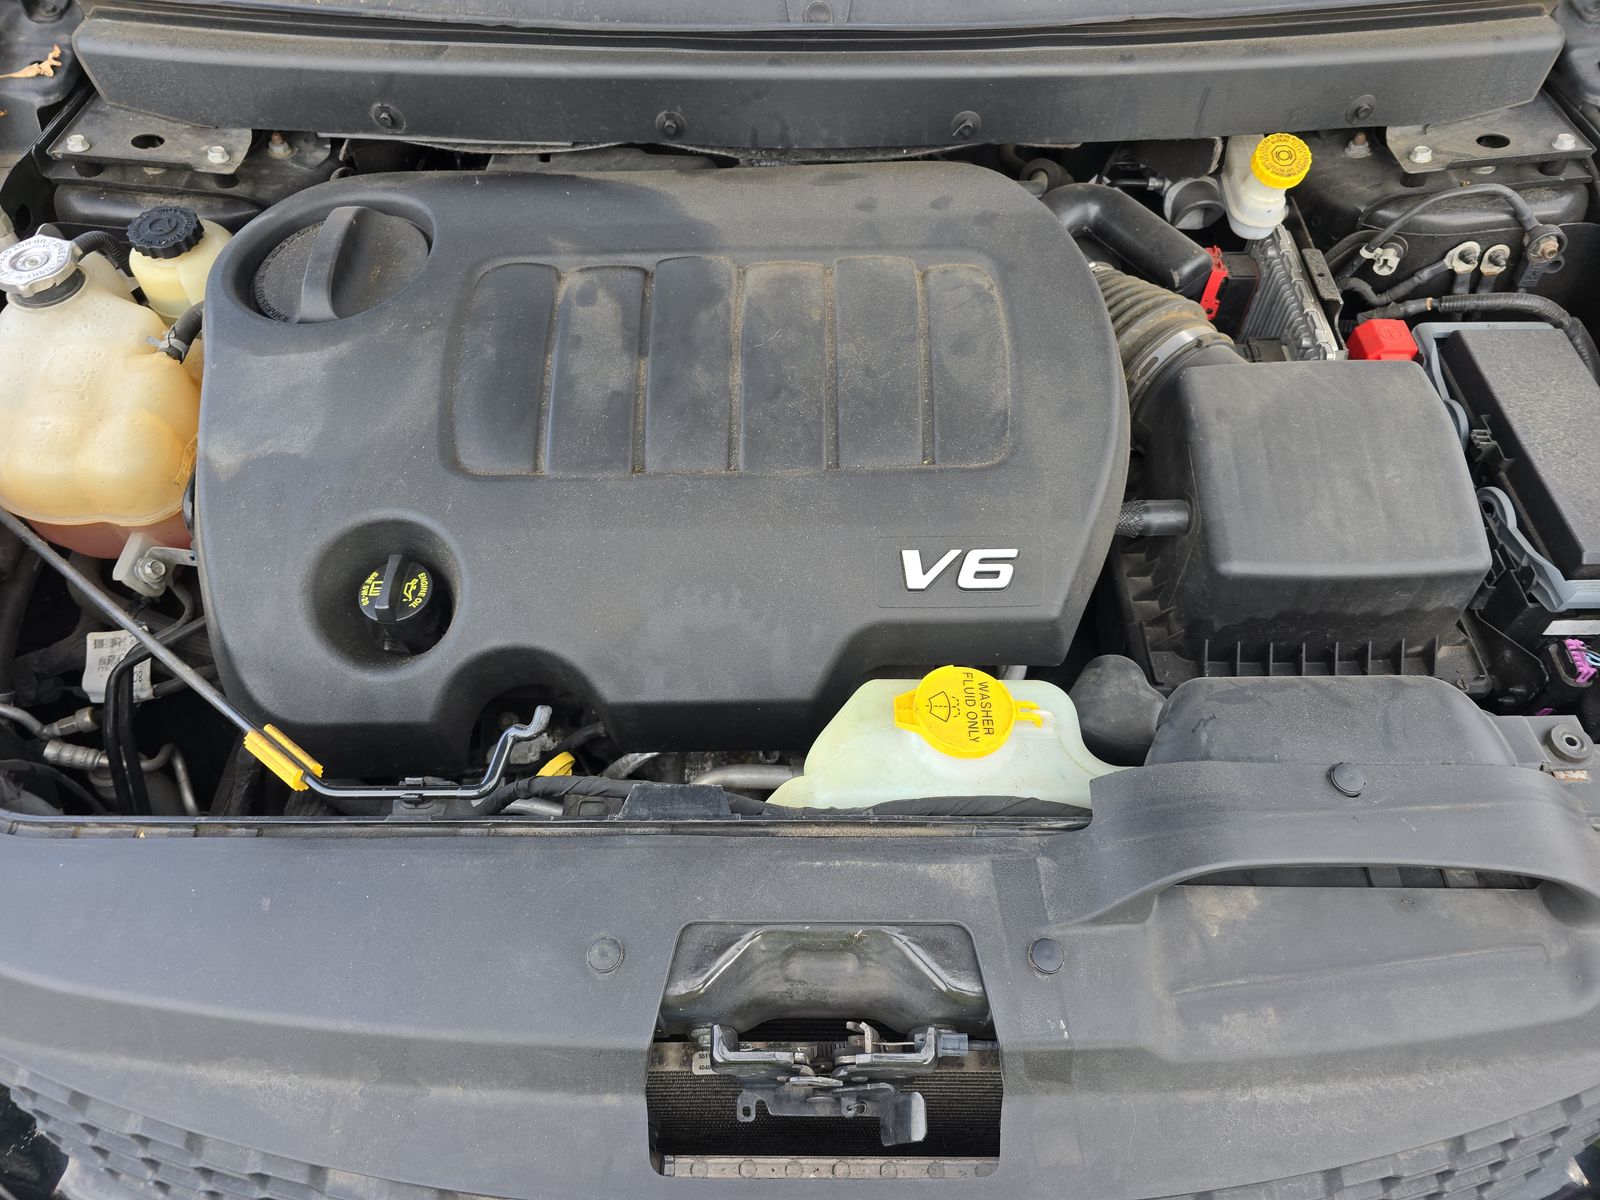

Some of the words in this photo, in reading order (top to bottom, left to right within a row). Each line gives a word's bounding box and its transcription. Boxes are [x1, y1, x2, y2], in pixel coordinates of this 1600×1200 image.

[365, 571, 379, 585] SAE
[417, 571, 428, 598] ENGINE
[900, 548, 1020, 592] V6
[360, 584, 370, 607] 5W-20
[408, 597, 423, 609] OIL
[962, 672, 977, 707] FLUID
[978, 681, 995, 736] WASHER
[965, 711, 981, 744] ONLY
